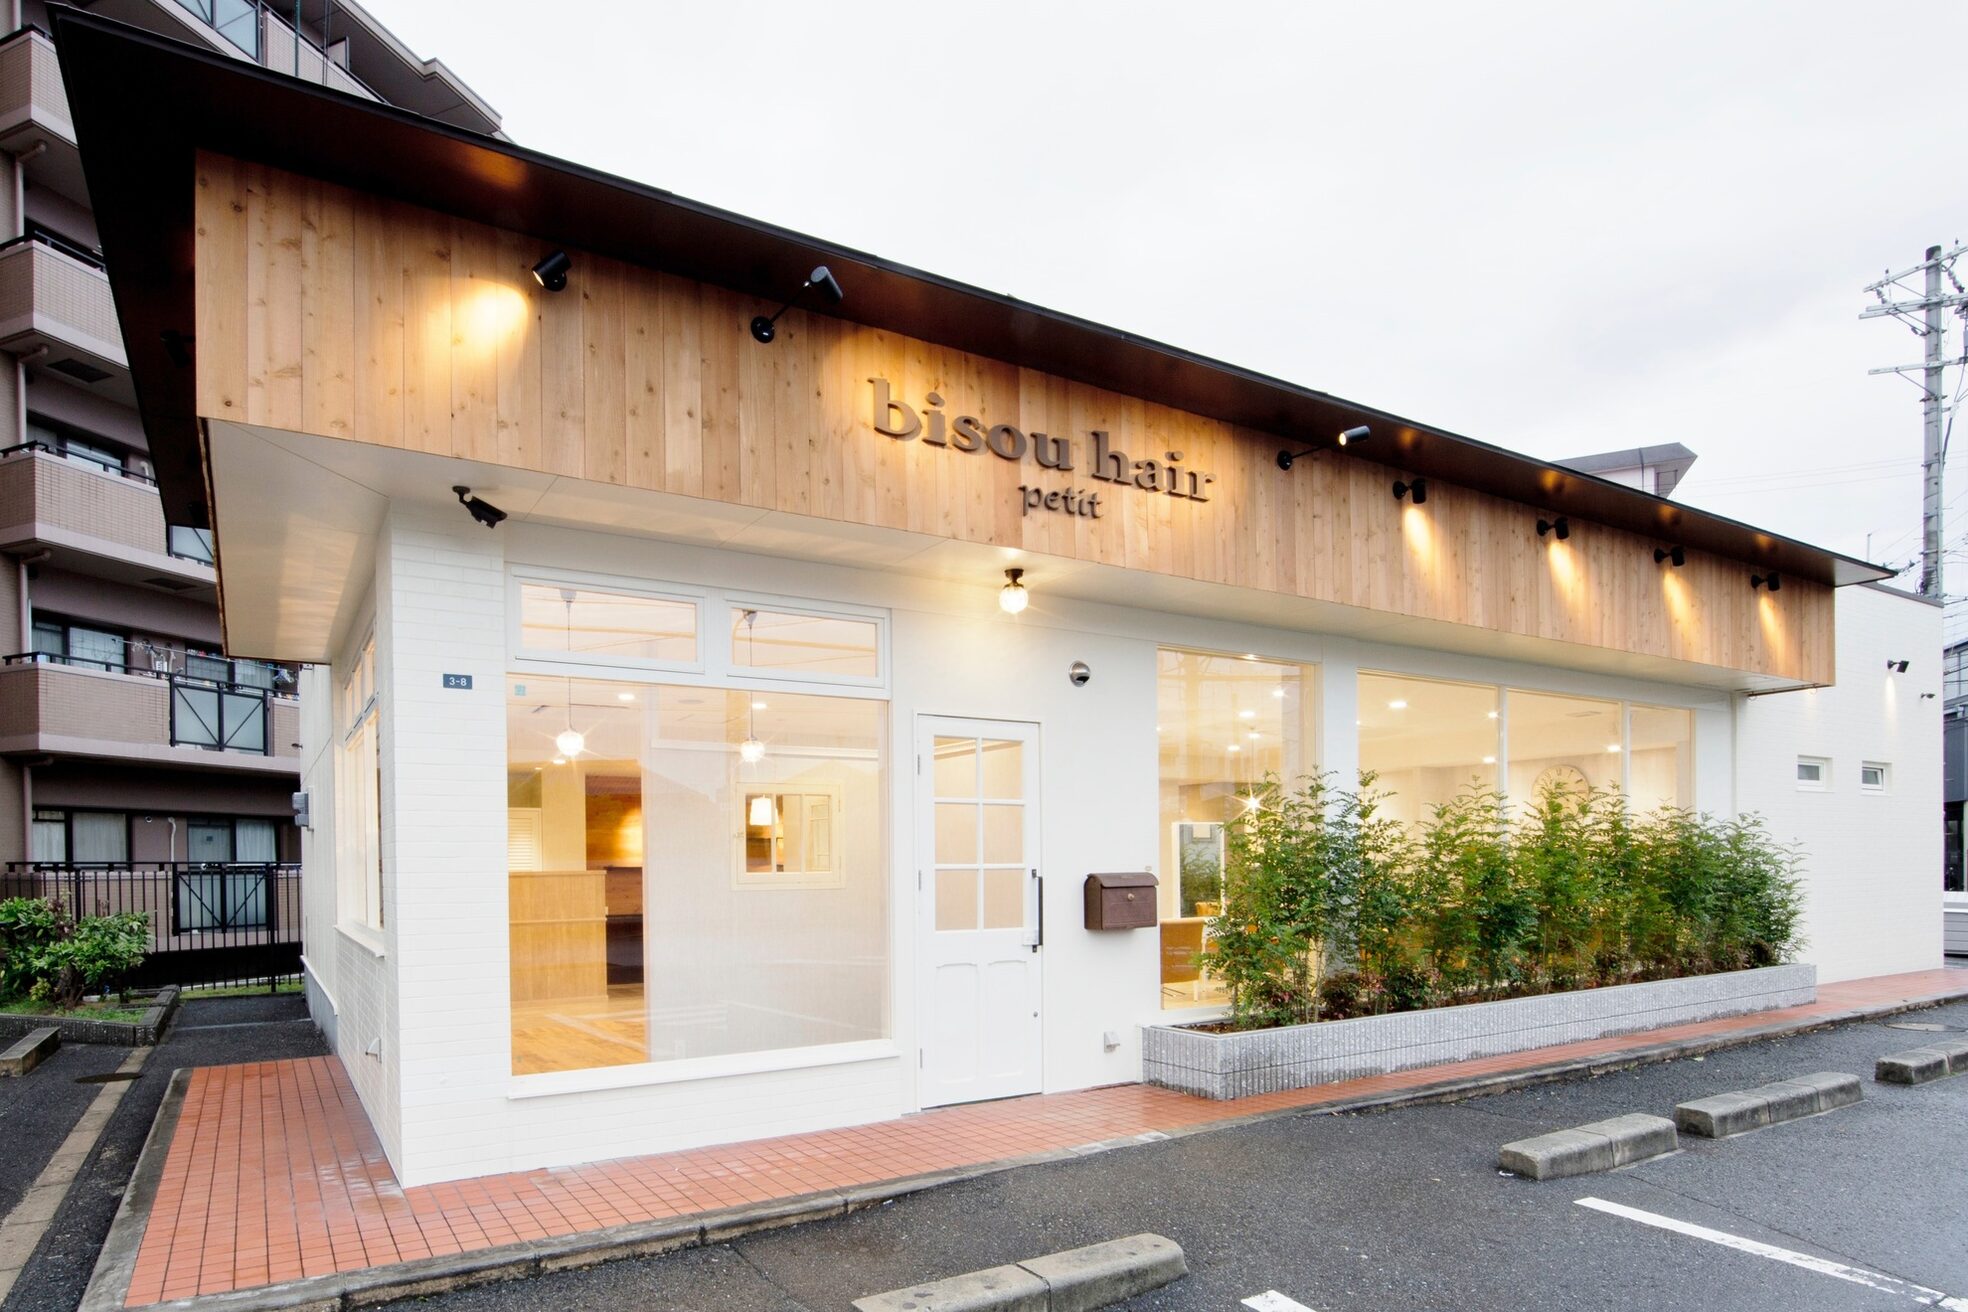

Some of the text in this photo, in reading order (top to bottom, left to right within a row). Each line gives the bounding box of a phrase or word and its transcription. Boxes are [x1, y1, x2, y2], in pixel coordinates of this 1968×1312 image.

[867, 377, 1217, 503] bisou hair
[1018, 485, 1103, 519] petit
[449, 676, 467, 687] 3-8
